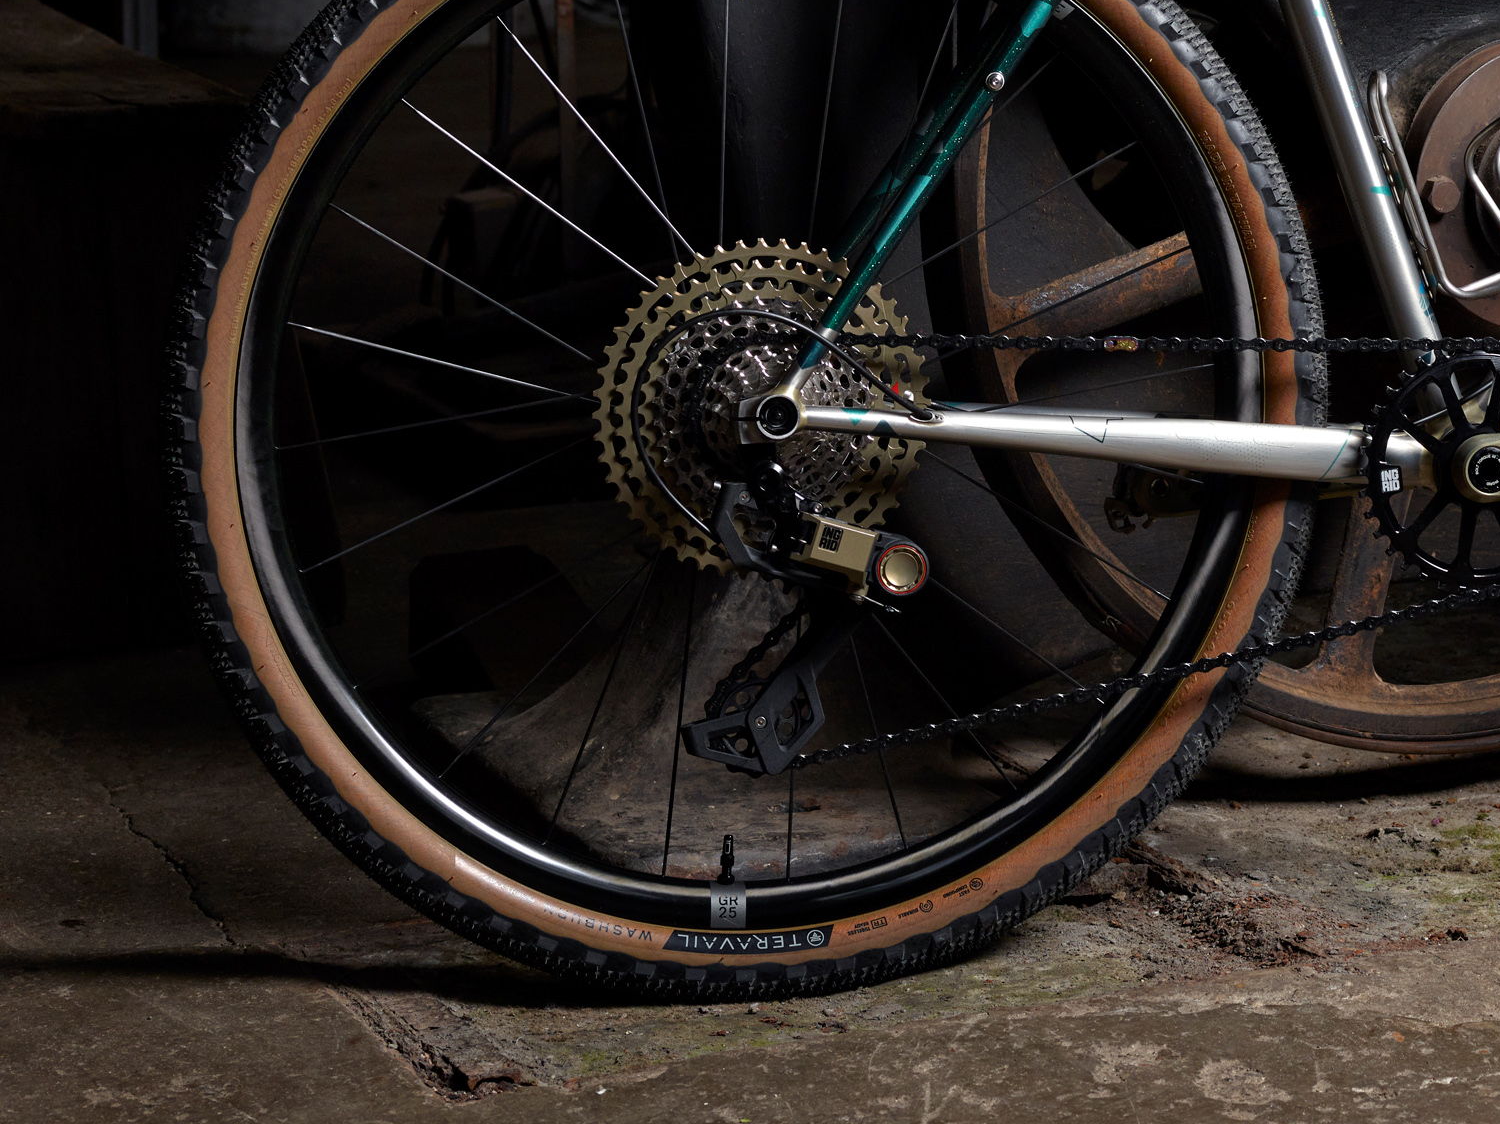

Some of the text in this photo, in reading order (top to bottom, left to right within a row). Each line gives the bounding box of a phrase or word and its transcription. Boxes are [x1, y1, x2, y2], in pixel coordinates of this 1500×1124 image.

[1196, 129, 1257, 250] MADE IN TAIWAN
[228, 315, 240, 344] KEEP
[234, 256, 255, 313] INFLATED
[1381, 468, 1399, 481] ING
[1382, 479, 1400, 493] RID
[822, 524, 842, 540] ING
[819, 538, 839, 552] RID
[958, 888, 970, 897] FAST
[718, 896, 738, 906] GR
[718, 906, 737, 919] 25
[897, 907, 919, 919] DURABLE
[542, 904, 653, 943] WASHBURN
[854, 921, 869, 929] READY
[873, 918, 884, 926] TR
[847, 926, 870, 935] TUBELESS
[676, 929, 801, 950] TERAVAIL
